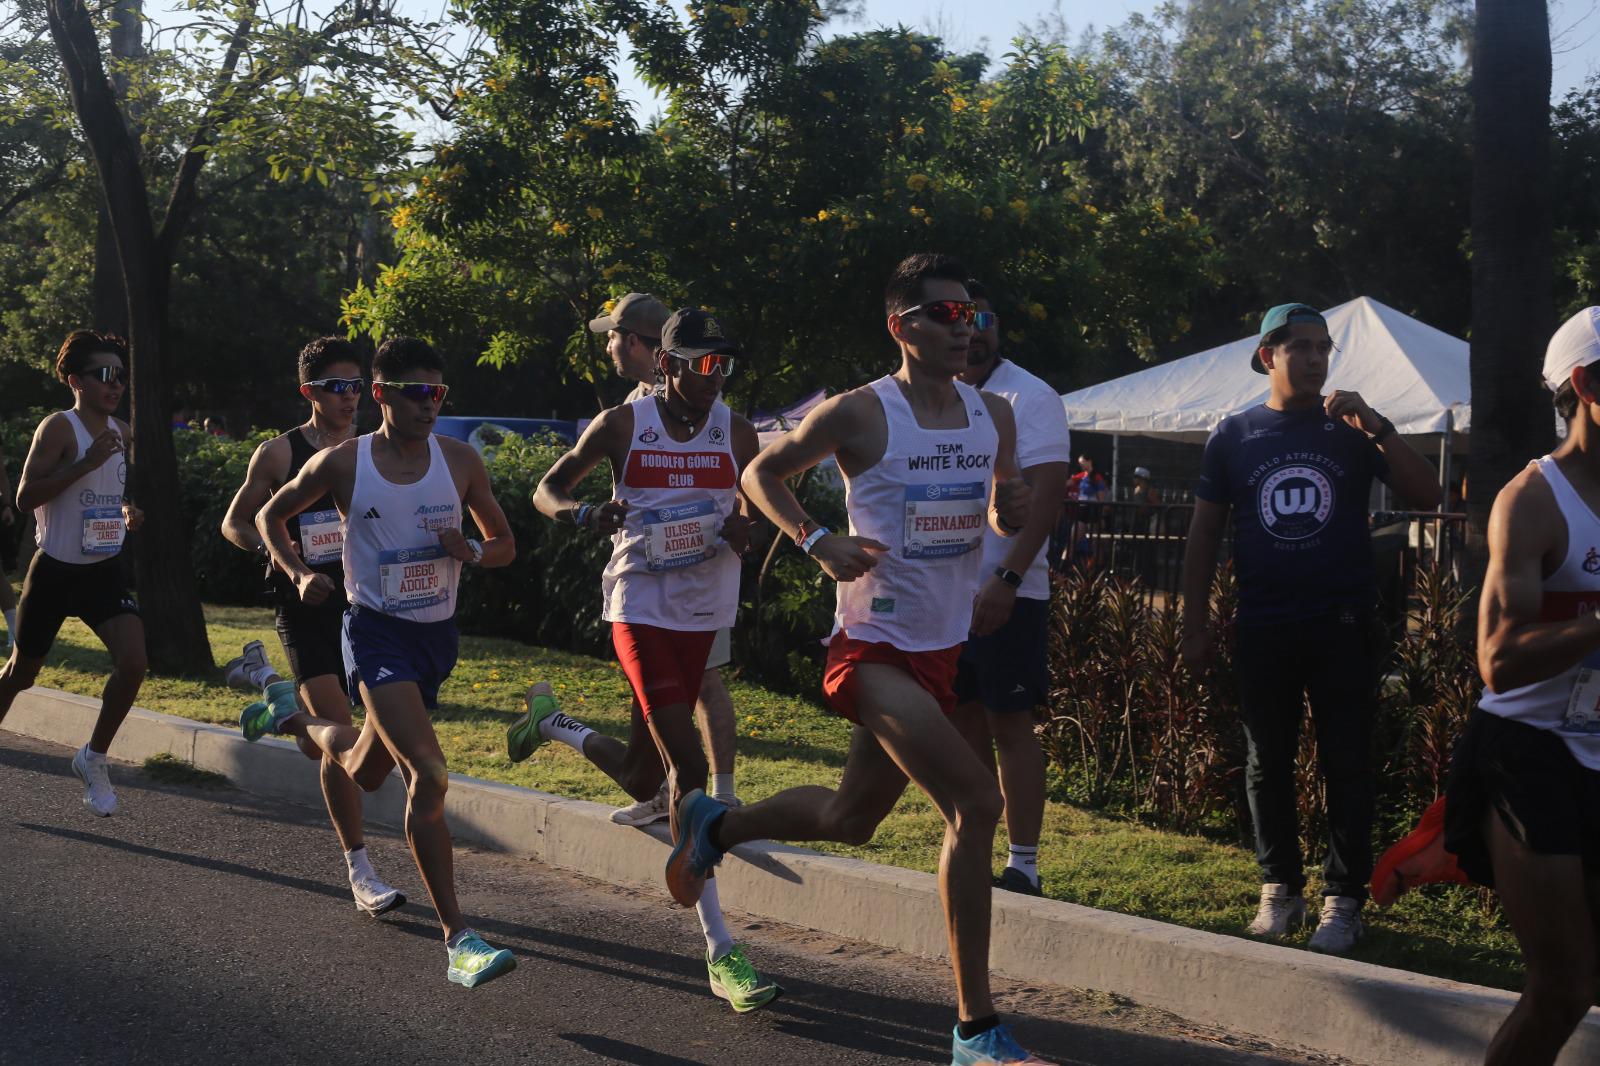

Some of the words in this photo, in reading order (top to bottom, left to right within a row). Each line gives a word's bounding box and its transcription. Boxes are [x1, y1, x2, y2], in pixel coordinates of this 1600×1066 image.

[936, 444, 963, 454] TEAM
[641, 454, 684, 469] RODOLFO
[687, 453, 720, 469] GÓMEZ
[908, 455, 951, 471] WHITE
[957, 454, 991, 469] ROCK
[1248, 457, 1280, 486] WORLD
[1286, 452, 1344, 477] ATHLETICS
[669, 474, 694, 487] CLUB
[415, 504, 455, 515] AKRON
[664, 522, 700, 540] ULISES
[914, 514, 981, 532] FERNANDO
[664, 534, 704, 553] ADRIAN
[403, 564, 435, 579] DIEGO
[399, 575, 439, 593] ADOLFO
[406, 591, 435, 599] CHANGAN
